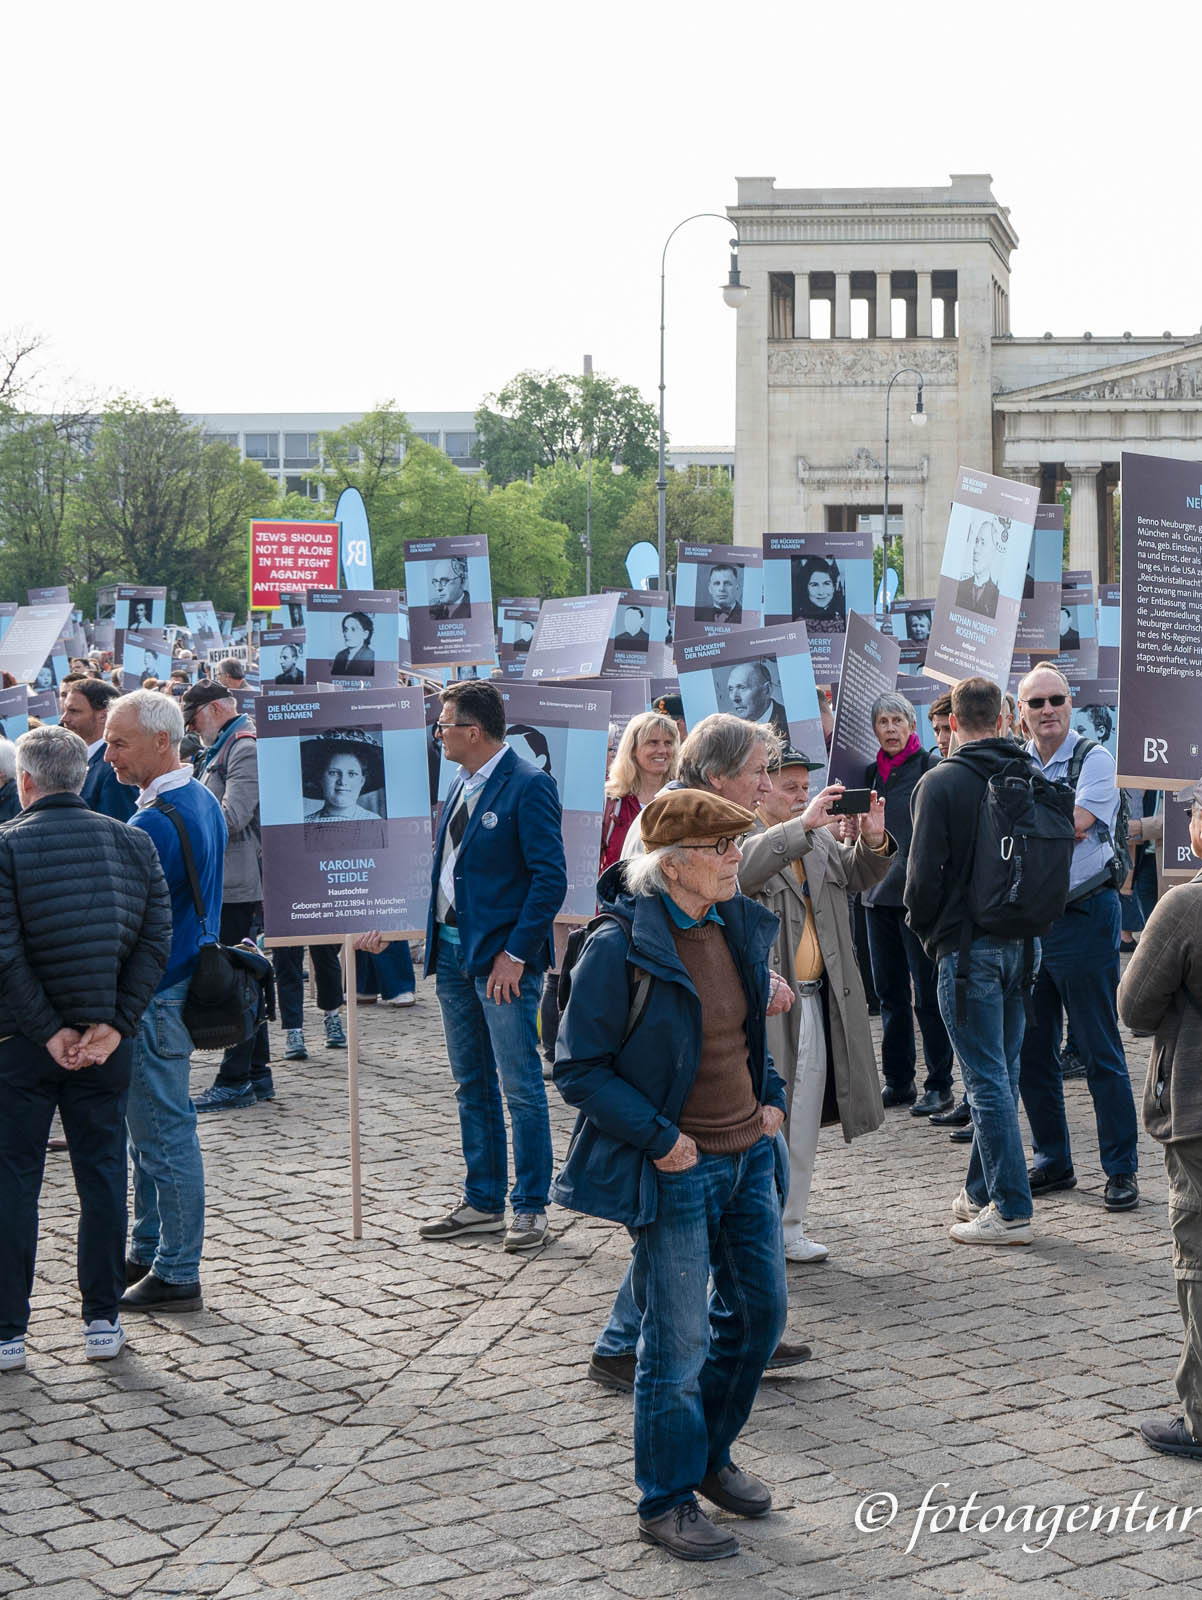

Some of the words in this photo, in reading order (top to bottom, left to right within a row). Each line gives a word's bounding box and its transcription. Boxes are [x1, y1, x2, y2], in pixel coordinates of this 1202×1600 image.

[1137, 515, 1159, 526] Benno
[1160, 518, 1196, 533] Neuburger,
[256, 532, 287, 542] JEWS
[291, 534, 332, 543] SHOULD
[1137, 526, 1169, 539] München
[1171, 531, 1180, 540] als
[256, 545, 278, 554] NOT
[282, 546, 295, 555] BE
[298, 546, 333, 555] ALONE
[259, 558, 271, 566] IN
[275, 558, 294, 566] THE
[298, 559, 330, 568] FIGHT
[270, 570, 318, 580] AGAINST
[254, 582, 334, 592] ANTISEMITISM
[1136, 606, 1147, 616] die
[1137, 617, 1172, 631] Neuburger
[1137, 630, 1145, 638] ne
[1147, 630, 1159, 639] des
[1161, 631, 1200, 646] NS-Regimes
[695, 642, 726, 652] RÜCKKEHR
[698, 649, 720, 658] NAMEN
[532, 669, 543, 677] BR
[1136, 663, 1145, 672] im
[1146, 663, 1194, 679] Strafgefängnis
[268, 705, 280, 713] DIE
[281, 703, 320, 712] RÜCKKEHR
[401, 700, 410, 709] BR
[588, 703, 597, 711] BR
[268, 713, 283, 721] DER
[284, 711, 312, 720] NAMEN
[1144, 737, 1168, 763] BR
[1177, 846, 1191, 861] BR
[320, 858, 376, 871] KAROLINA
[328, 872, 368, 883] STEIDLE
[328, 888, 368, 896] Haustochter
[292, 901, 320, 910] Geboren
[375, 897, 405, 905] München
[291, 911, 322, 919] Ermordet
[335, 909, 366, 917] 24.01.1941
